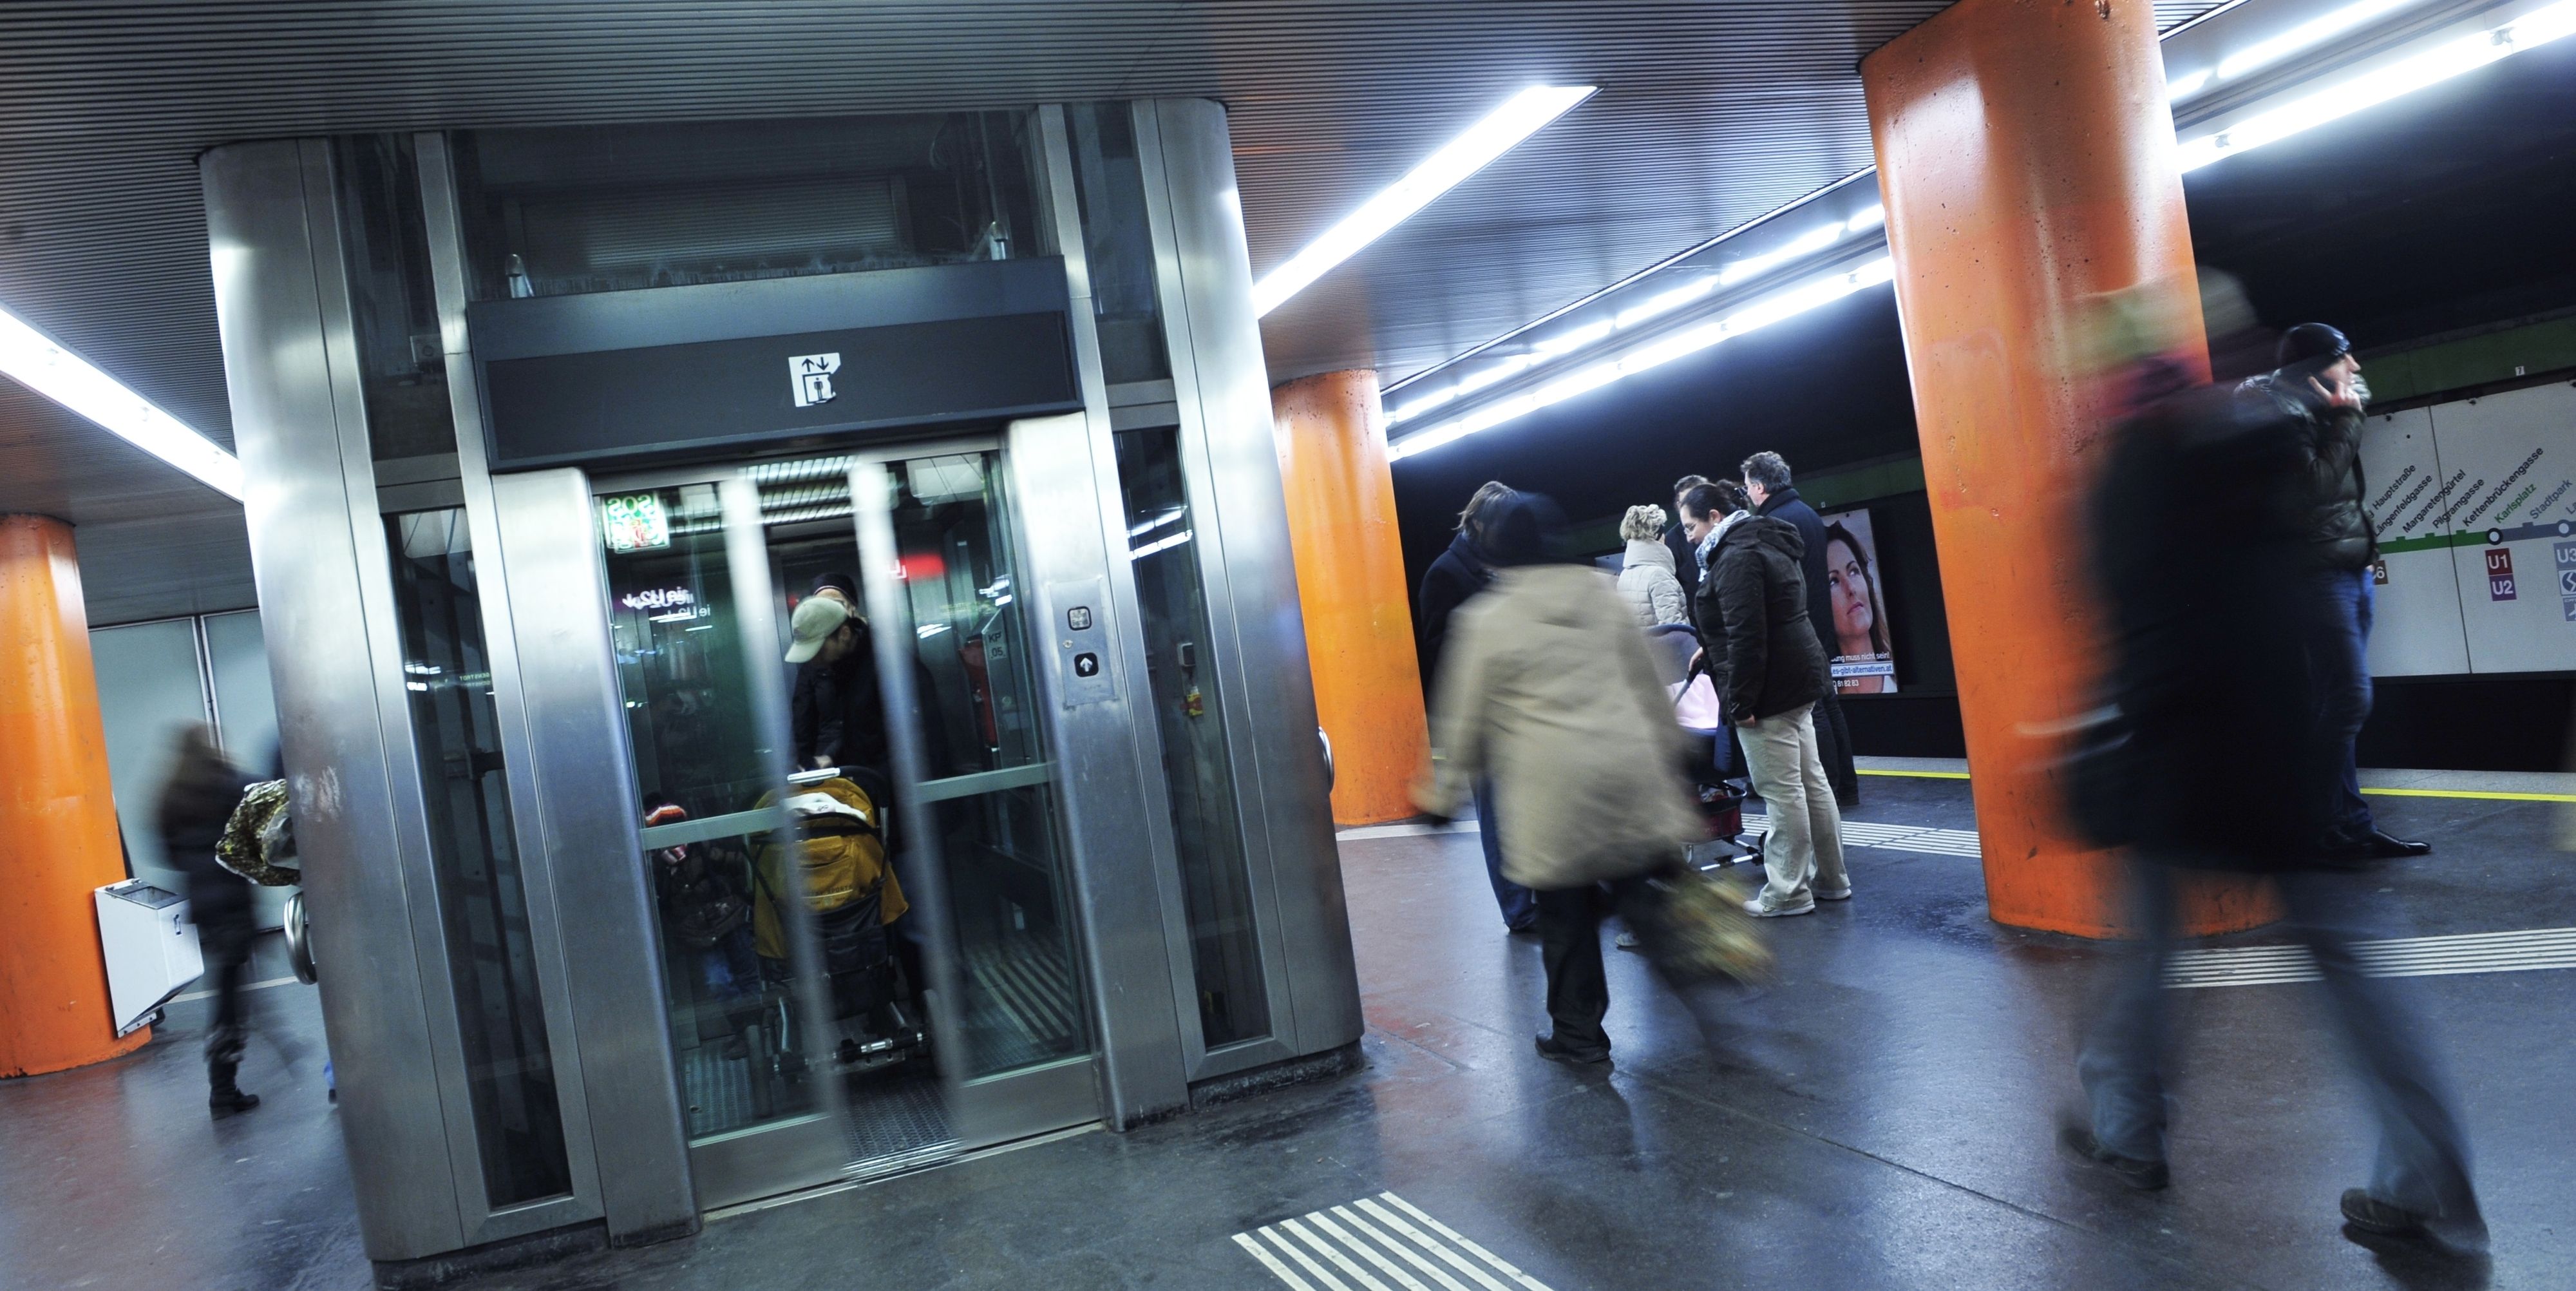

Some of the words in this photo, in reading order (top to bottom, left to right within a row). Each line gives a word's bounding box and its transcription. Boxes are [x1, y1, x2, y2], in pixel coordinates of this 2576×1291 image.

[2372, 464, 2416, 510] Hauptstraße
[2374, 475, 2432, 537] Längenfeldgasse
[2402, 469, 2467, 533] Margaretengürtel
[2432, 478, 2485, 529] Pilgramgasse
[2463, 447, 2544, 527] Kettenbrückengasse
[2494, 483, 2537, 524] Karlsplatz
[2530, 478, 2573, 519] Stadtpark
[2488, 554, 2508, 569] U1
[2492, 580, 2514, 595] U2
[989, 632, 1001, 643] KP
